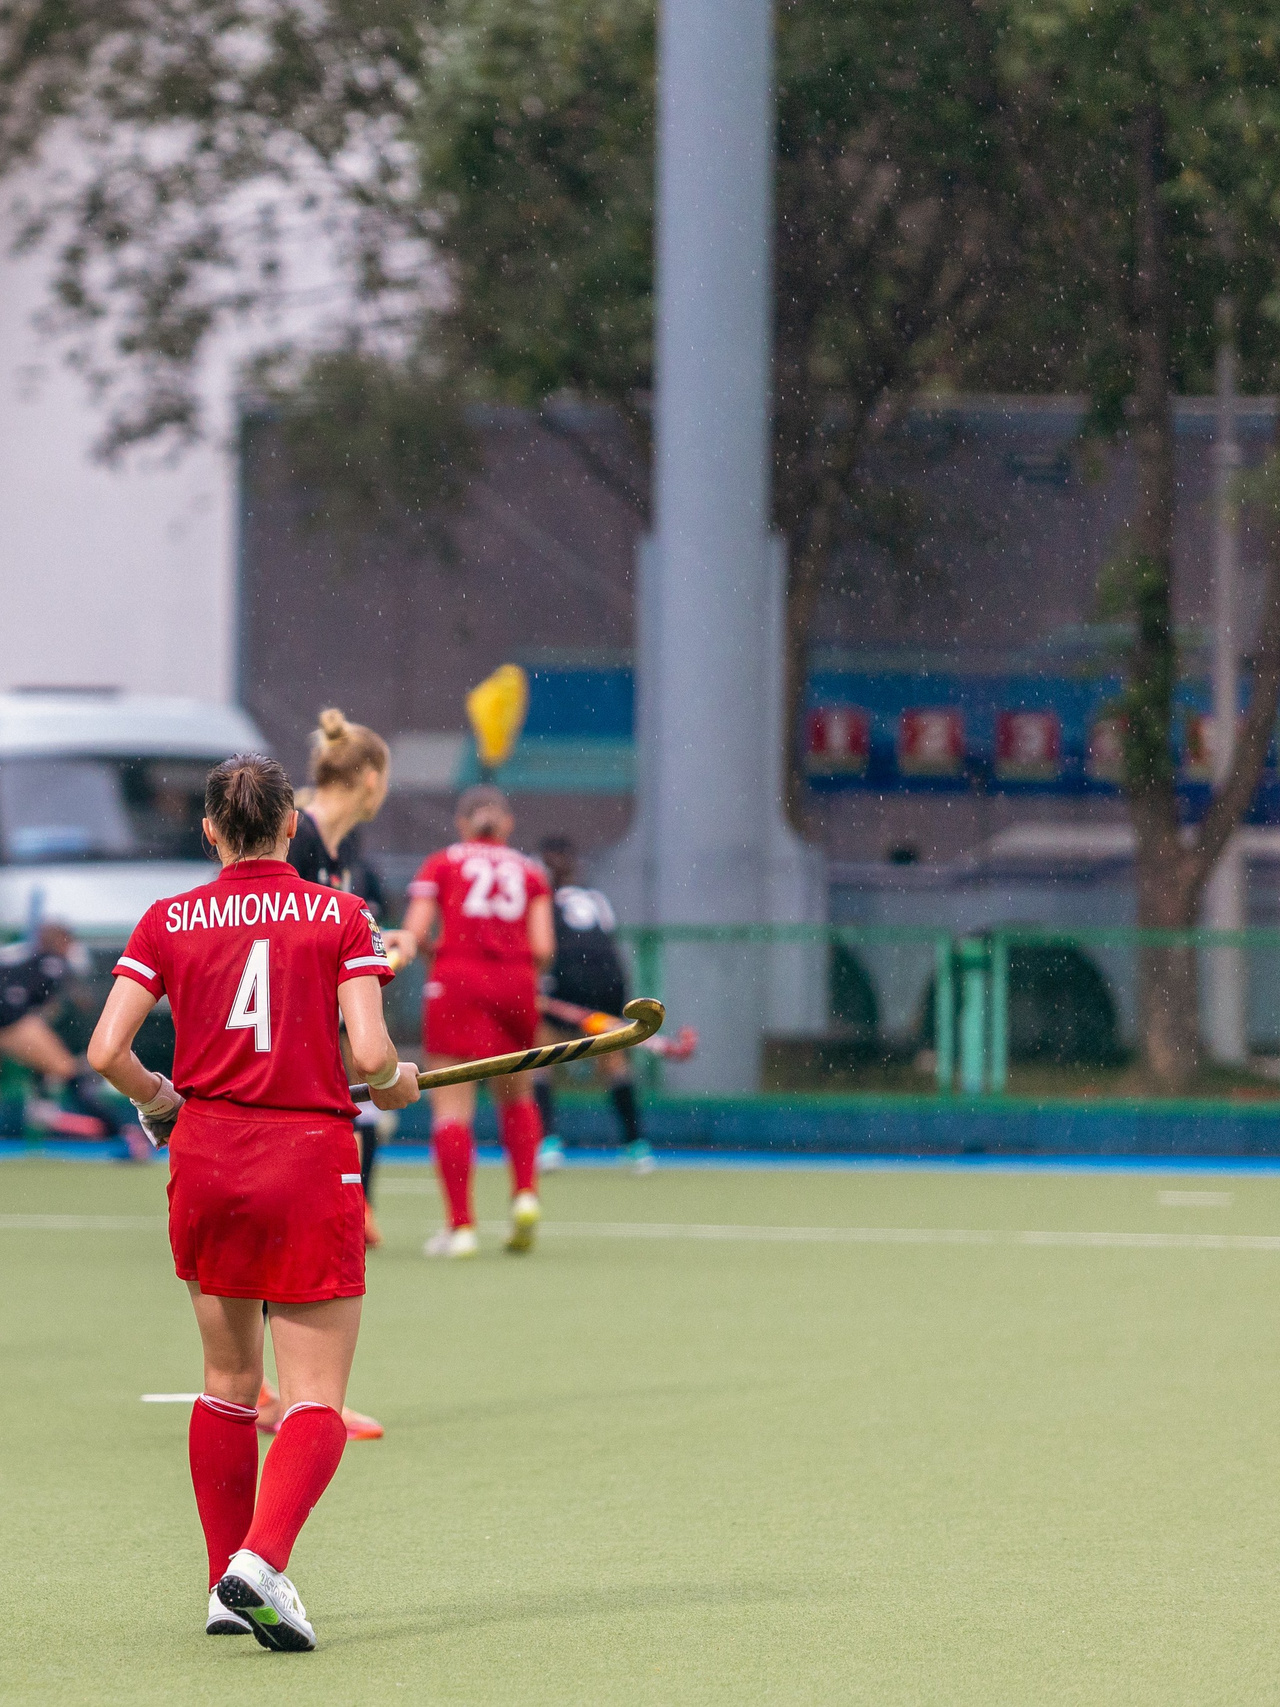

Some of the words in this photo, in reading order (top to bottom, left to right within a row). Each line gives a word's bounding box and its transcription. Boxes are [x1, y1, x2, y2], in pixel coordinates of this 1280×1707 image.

[166, 892, 341, 932] SIAMIONAVA
[462, 858, 527, 921] 23
[225, 938, 271, 1053] 4
